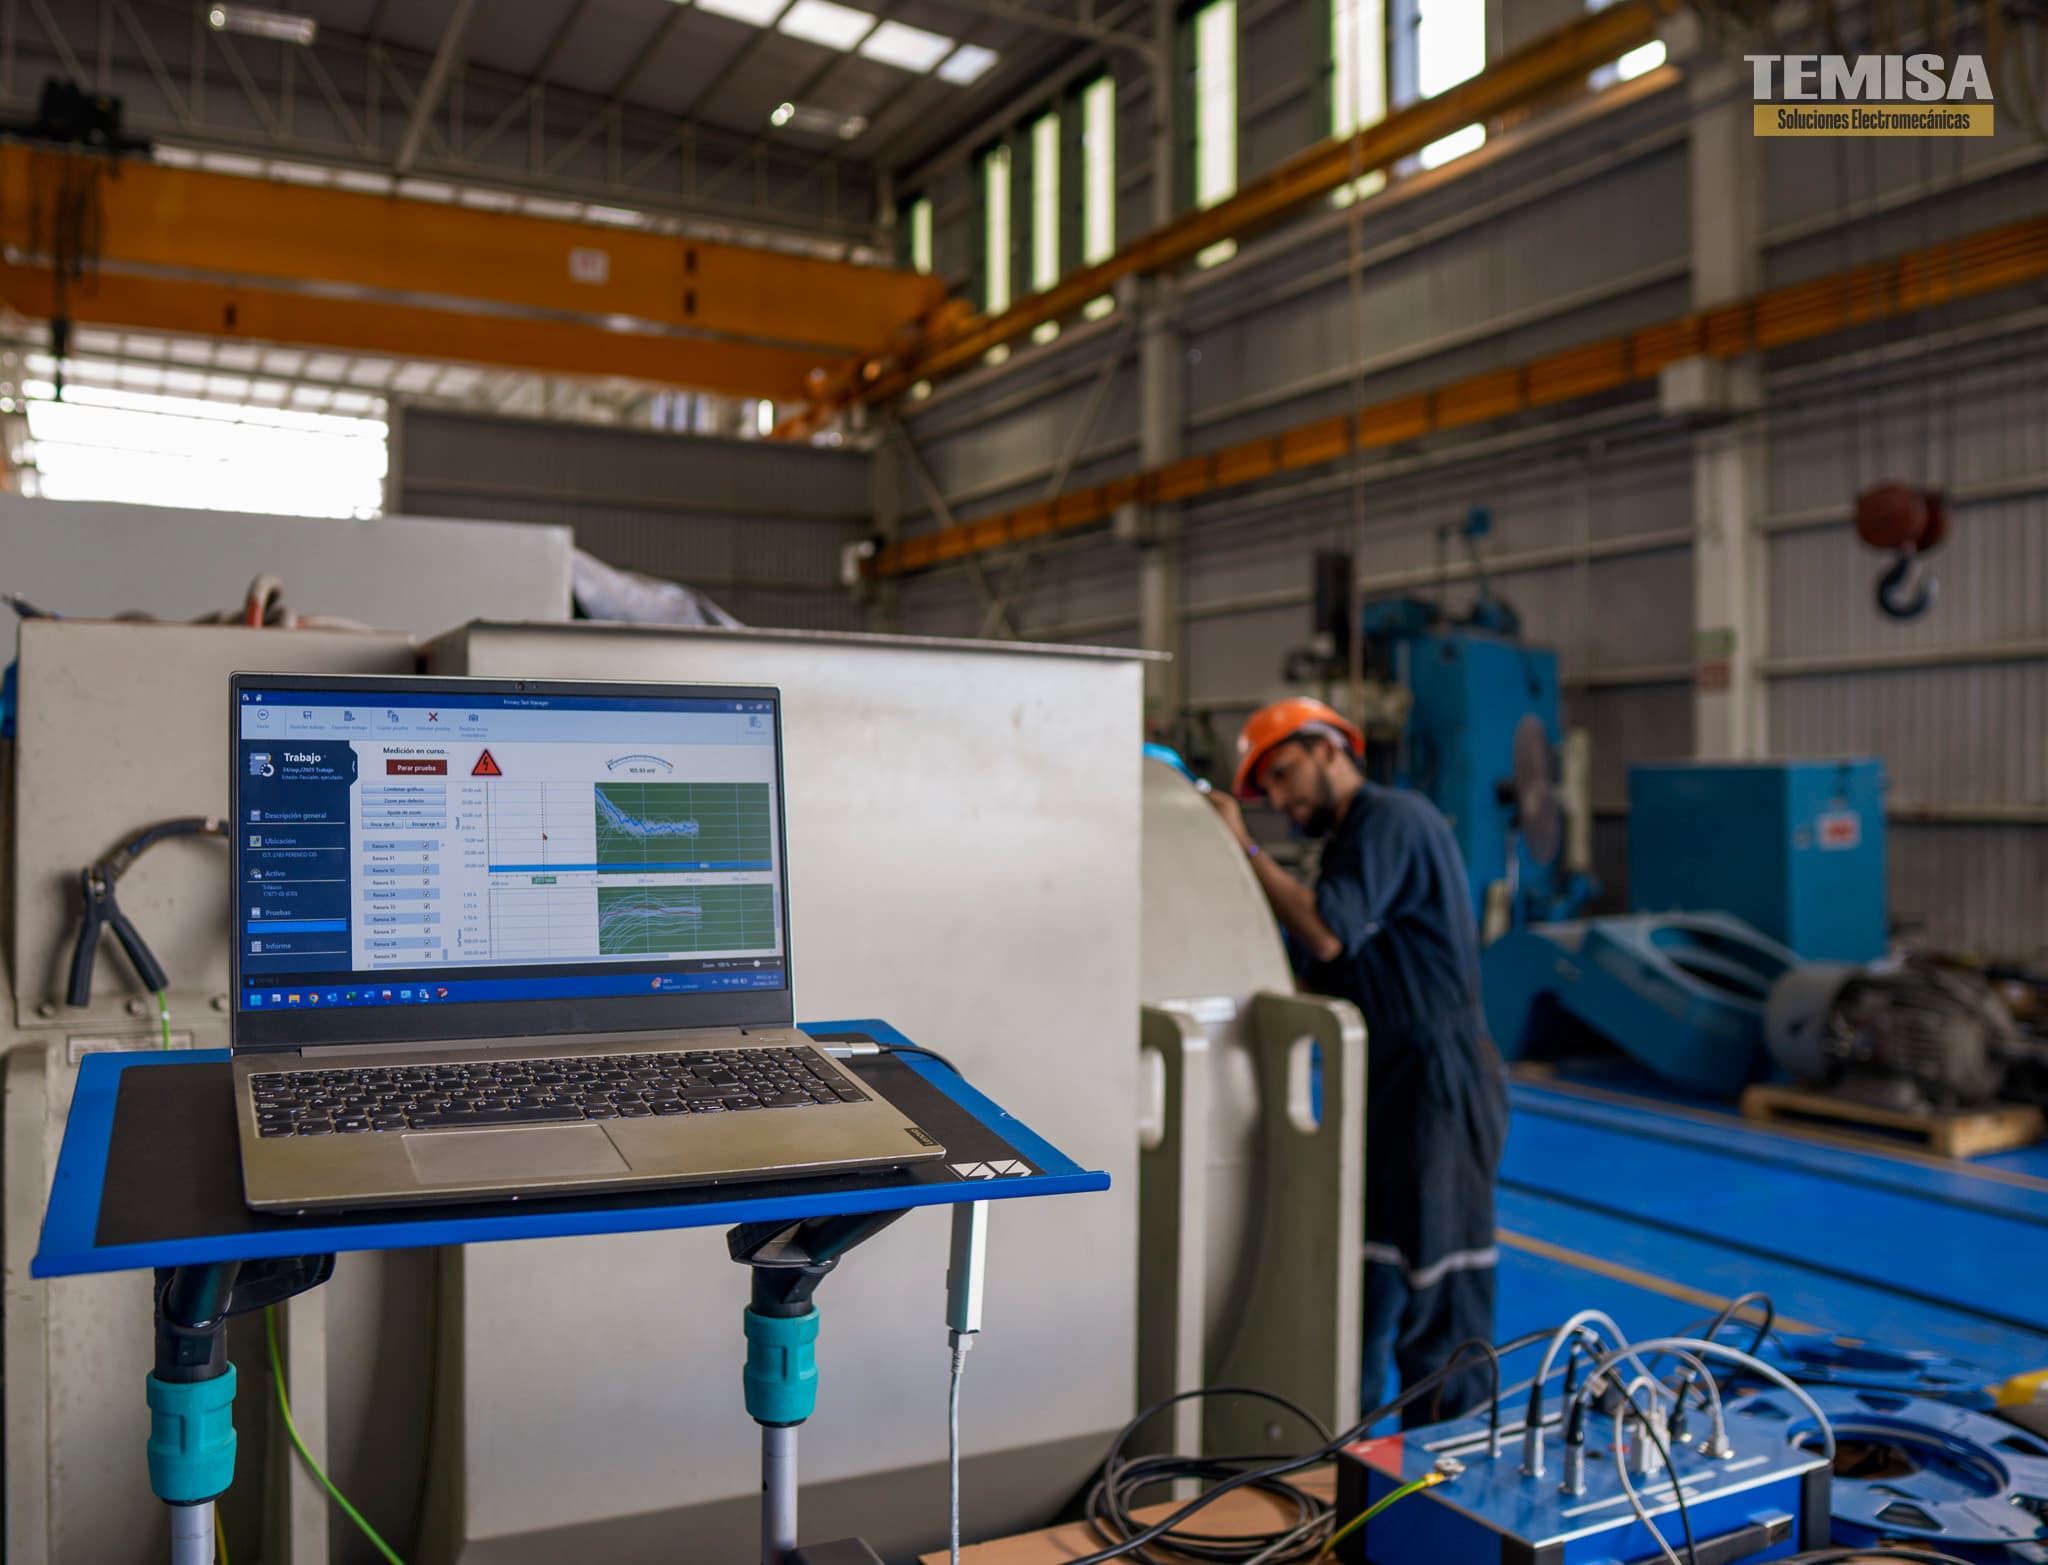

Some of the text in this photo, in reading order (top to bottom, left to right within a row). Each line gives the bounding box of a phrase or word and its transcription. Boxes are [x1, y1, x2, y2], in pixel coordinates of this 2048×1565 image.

[283, 752, 321, 764] Trabajo
[264, 812, 327, 820] Descripción general
